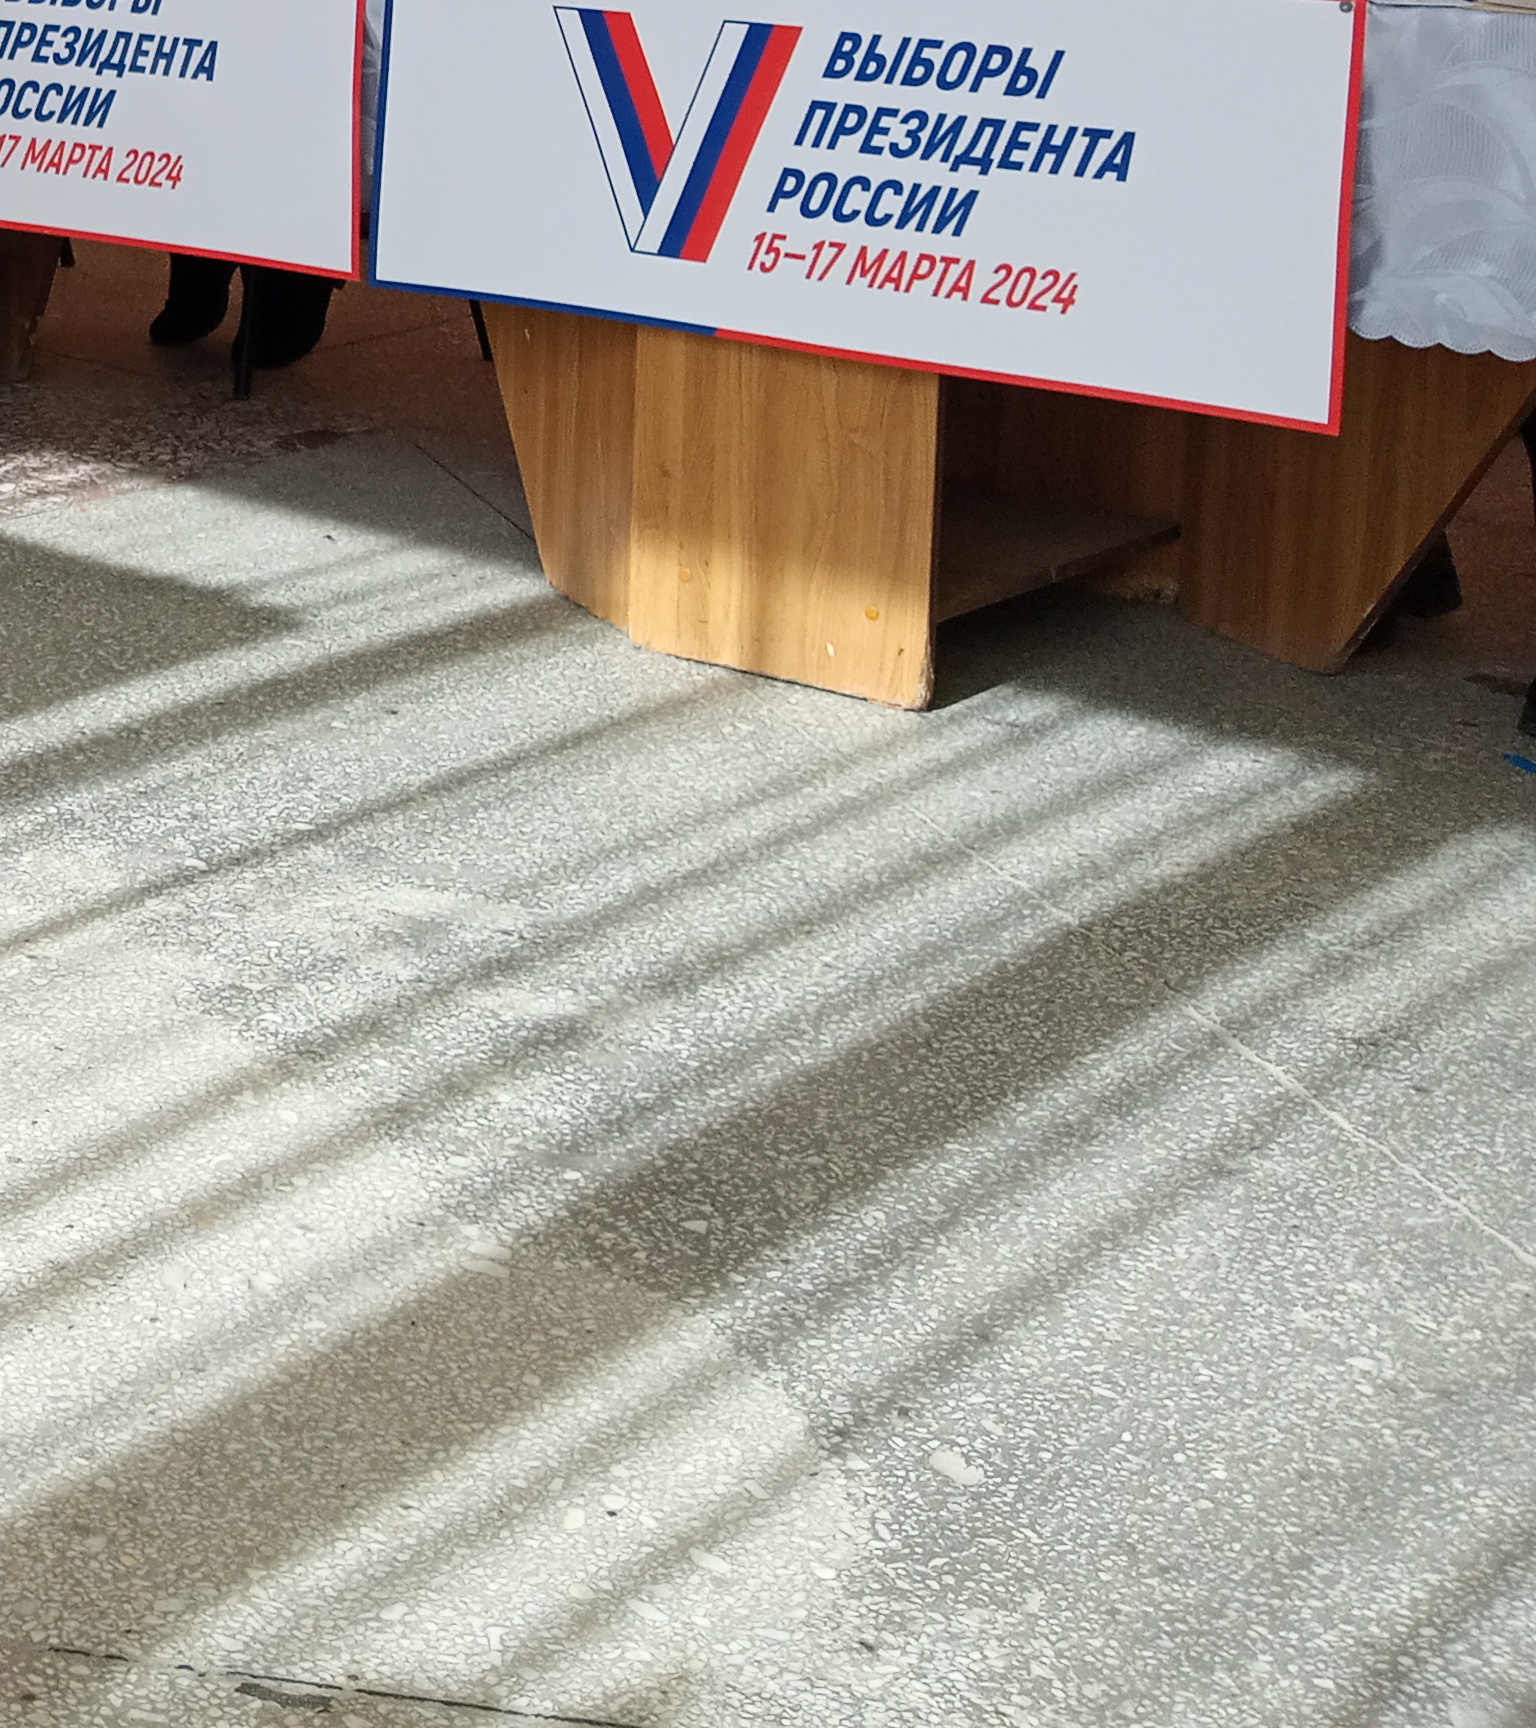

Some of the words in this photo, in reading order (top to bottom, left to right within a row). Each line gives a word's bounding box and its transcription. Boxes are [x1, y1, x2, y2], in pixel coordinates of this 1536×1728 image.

[822, 31, 1066, 100] ВЫБОРЫ
[20, 137, 114, 181] МАРТА
[116, 148, 184, 190] 2024
[794, 100, 1136, 182] ПРЕЗИДЕНТА
[766, 167, 980, 237] РОССИИ
[845, 245, 977, 302] МАРТА
[980, 263, 1079, 315] 2024
